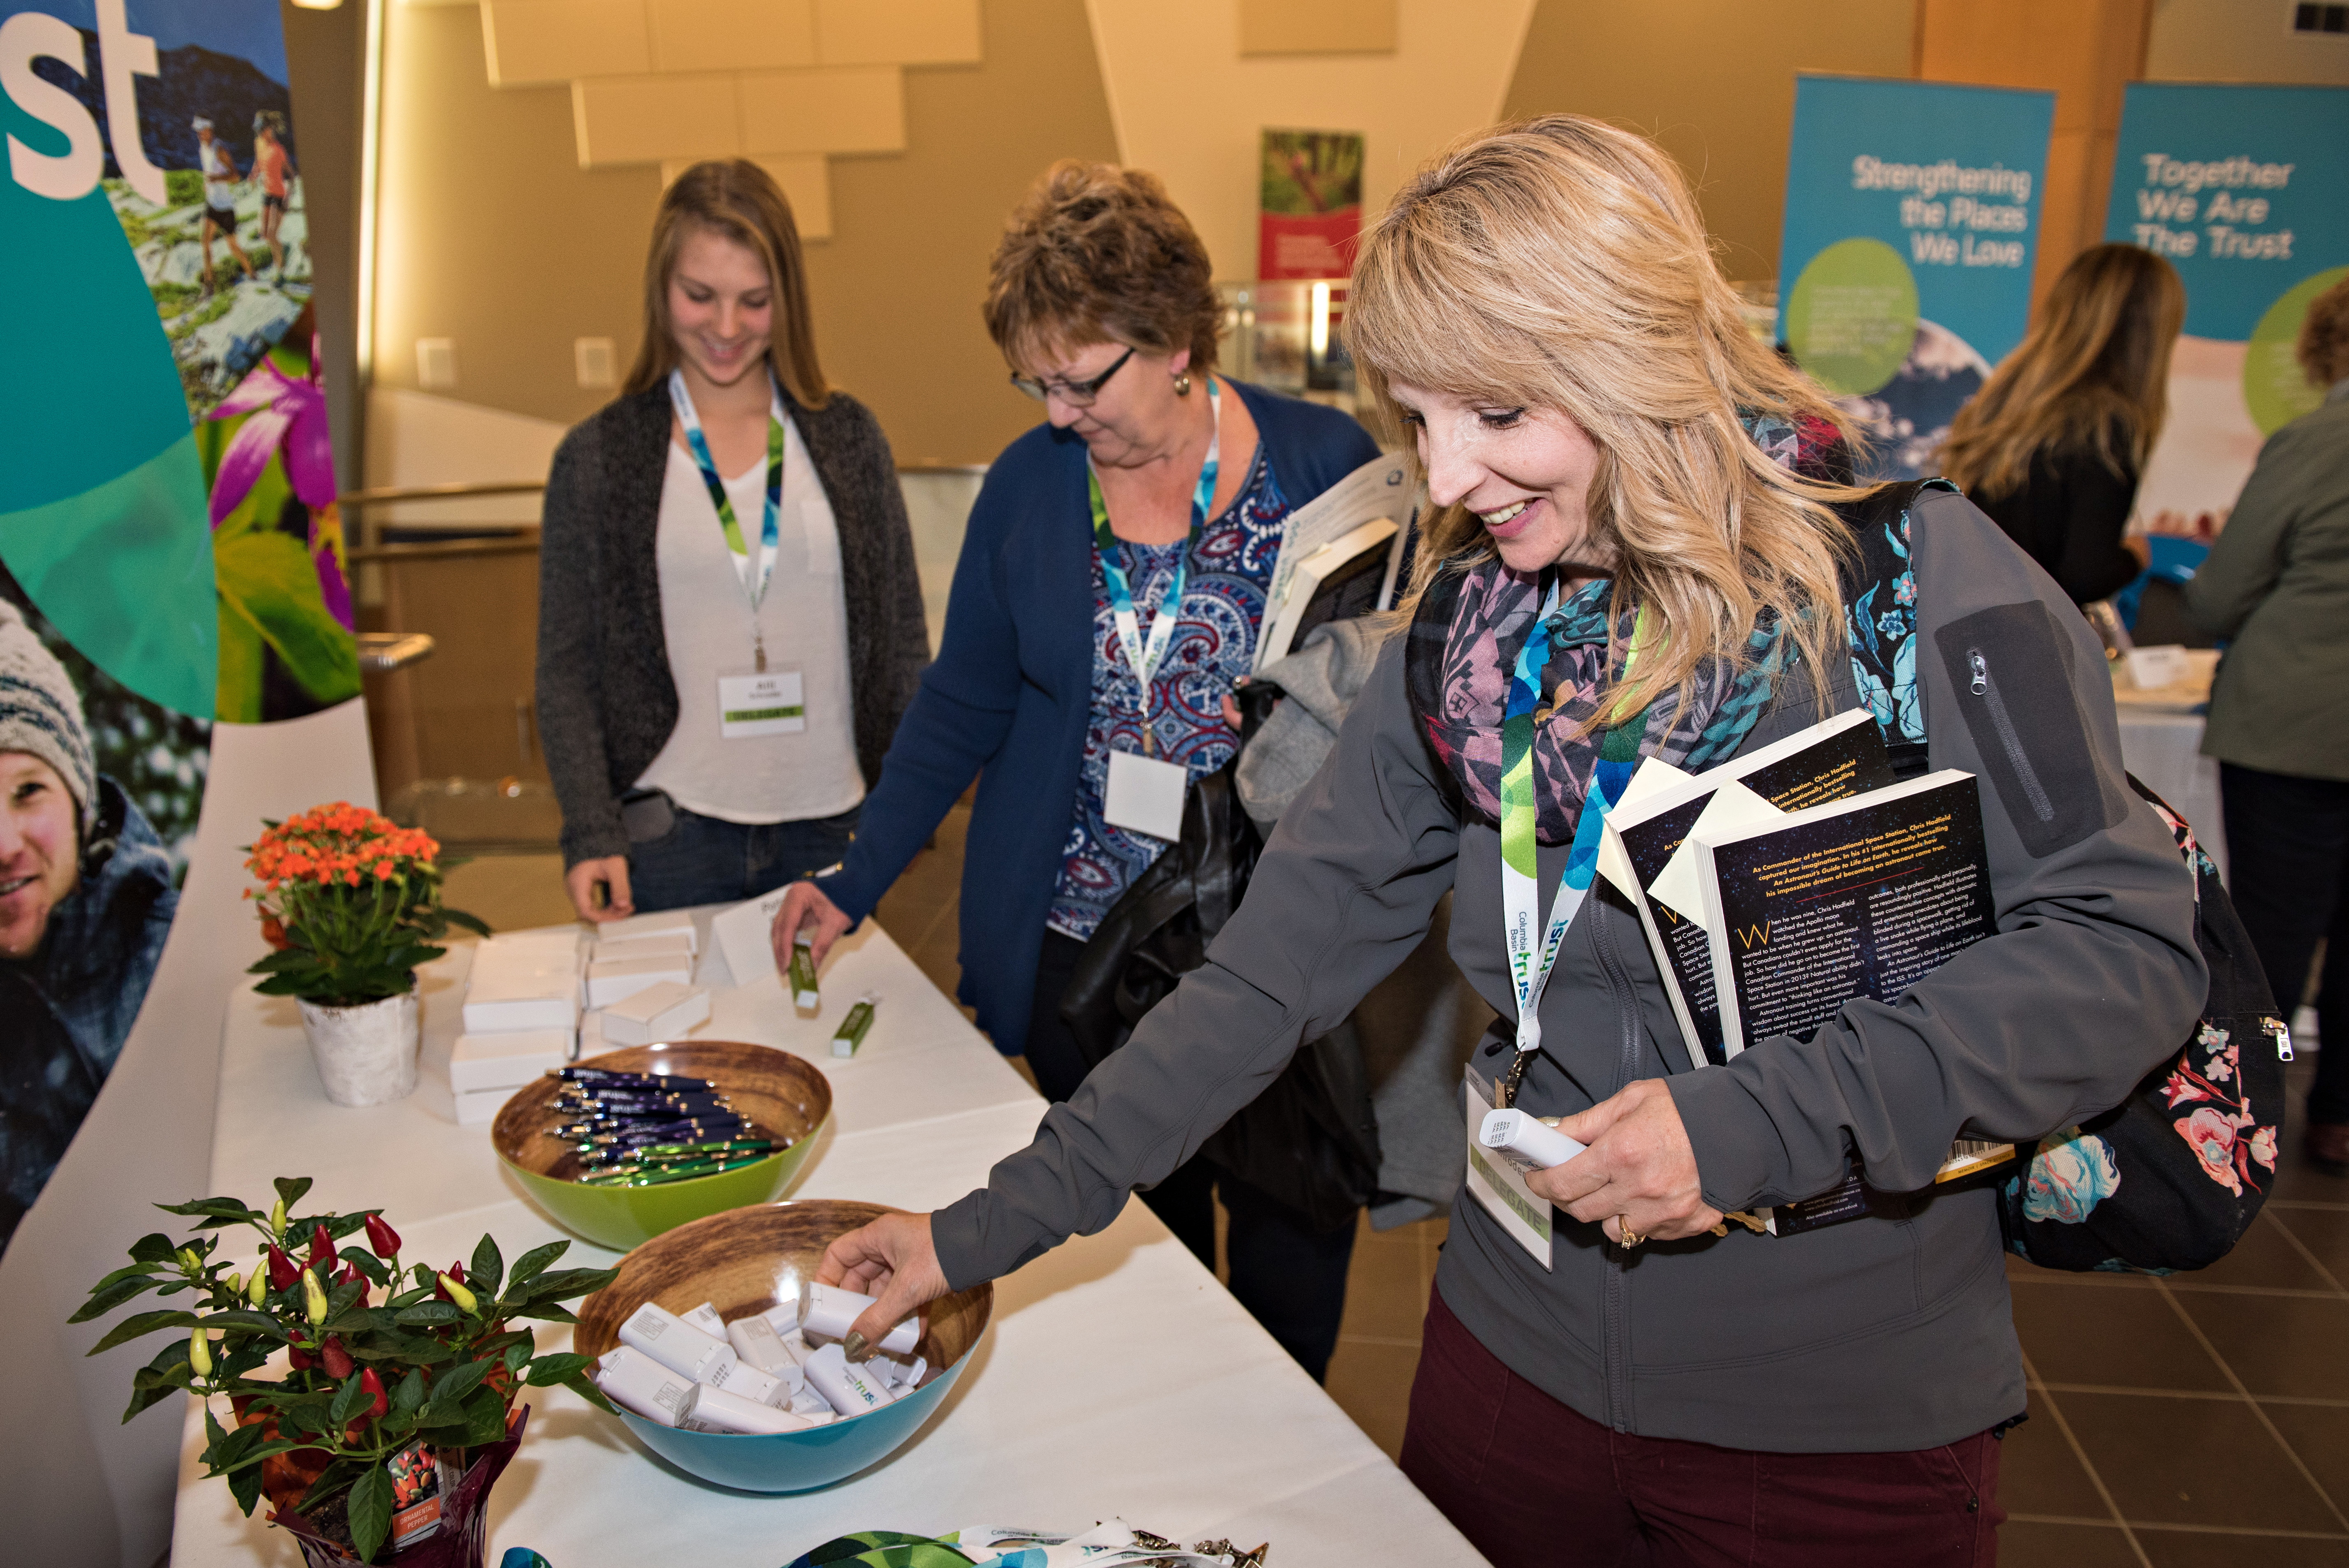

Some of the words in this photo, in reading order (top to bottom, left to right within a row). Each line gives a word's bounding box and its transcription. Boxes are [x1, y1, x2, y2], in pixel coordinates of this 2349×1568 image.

[1851, 154, 2032, 203] Strengthening
[2142, 153, 2296, 190] Together
[1900, 195, 1946, 229] the
[1949, 197, 2028, 234] Places
[2139, 189, 2198, 223] We
[2205, 193, 2270, 225] Are
[1910, 230, 1959, 266] We
[1962, 234, 2025, 268] Love
[2134, 223, 2198, 257] The
[2206, 225, 2296, 261] Trust
[1770, 791, 1789, 803] Space
[1790, 781, 1813, 794] Station,
[1814, 772, 1830, 782] Chris
[1830, 758, 1856, 775] Hadfield
[1778, 786, 1822, 809] internationally
[1822, 770, 1855, 789] bestselling
[1809, 791, 1832, 805] reveals
[1831, 784, 1845, 794] how
[1758, 868, 1787, 881] captured
[1801, 856, 1842, 870] imagination.
[1871, 834, 1916, 851] internationally
[1916, 826, 1948, 838] bestselling
[1762, 857, 1802, 870] Commander
[1823, 839, 1864, 855] International
[1864, 835, 1884, 844] Space
[1885, 829, 1908, 838] Station,
[1909, 822, 1925, 831] Chris
[1925, 814, 1951, 826] Hadfield
[1776, 881, 1811, 895] impossible
[1813, 876, 1834, 886] dream
[1843, 865, 1874, 877] becoming
[1885, 853, 1914, 866] astronaut
[1915, 849, 1931, 857] came
[1784, 870, 1820, 884] Astronaut's
[1821, 864, 1841, 874] Guide
[1850, 858, 1862, 867] Life
[1872, 851, 1890, 861] Earth,
[1901, 841, 1924, 852] reveals
[1868, 890, 1894, 900] outcomes,
[1894, 884, 1907, 893] both
[1907, 874, 1941, 891] professionally
[1941, 870, 1952, 879] and
[1952, 863, 1977, 877] personally,
[1879, 893, 1912, 906] resoundingly
[1912, 888, 1933, 898] positive.
[1934, 879, 1954, 890] Hadfield
[1955, 873, 1977, 883] illustrates
[1885, 900, 1922, 914] counterintuitive
[1923, 893, 1945, 902] concepts
[1956, 882, 1977, 892] dramatic
[1832, 898, 1855, 910] Hadfield
[1519, 911, 1527, 951] Columbia
[1741, 949, 1762, 959] wanted
[1801, 938, 1815, 946] grew
[1834, 925, 1860, 936] astronaut.
[1772, 923, 1795, 934] watched
[1806, 916, 1824, 926] Apollo
[1773, 934, 1794, 943] landing
[1795, 929, 1806, 937] and
[1539, 919, 1569, 972] trust
[1752, 955, 1782, 965] Canadians
[1782, 948, 1804, 958] couldn't
[1818, 941, 1834, 950] apply
[1513, 952, 1532, 1010] trus
[1745, 975, 1772, 985] Canadian
[1773, 966, 1806, 978] Commander
[1822, 952, 1855, 966] International
[1746, 986, 1764, 994] Space
[1791, 973, 1809, 983] 2013?
[1810, 967, 1831, 978] Natural
[1831, 964, 1848, 972] ability
[1849, 959, 1864, 968] didn't
[1529, 972, 1545, 1008] Columbia
[853, 1380, 878, 1406] trust
[400, 1504, 434, 1525] ORNAMENTAL
[407, 1515, 429, 1529] PEPPER
